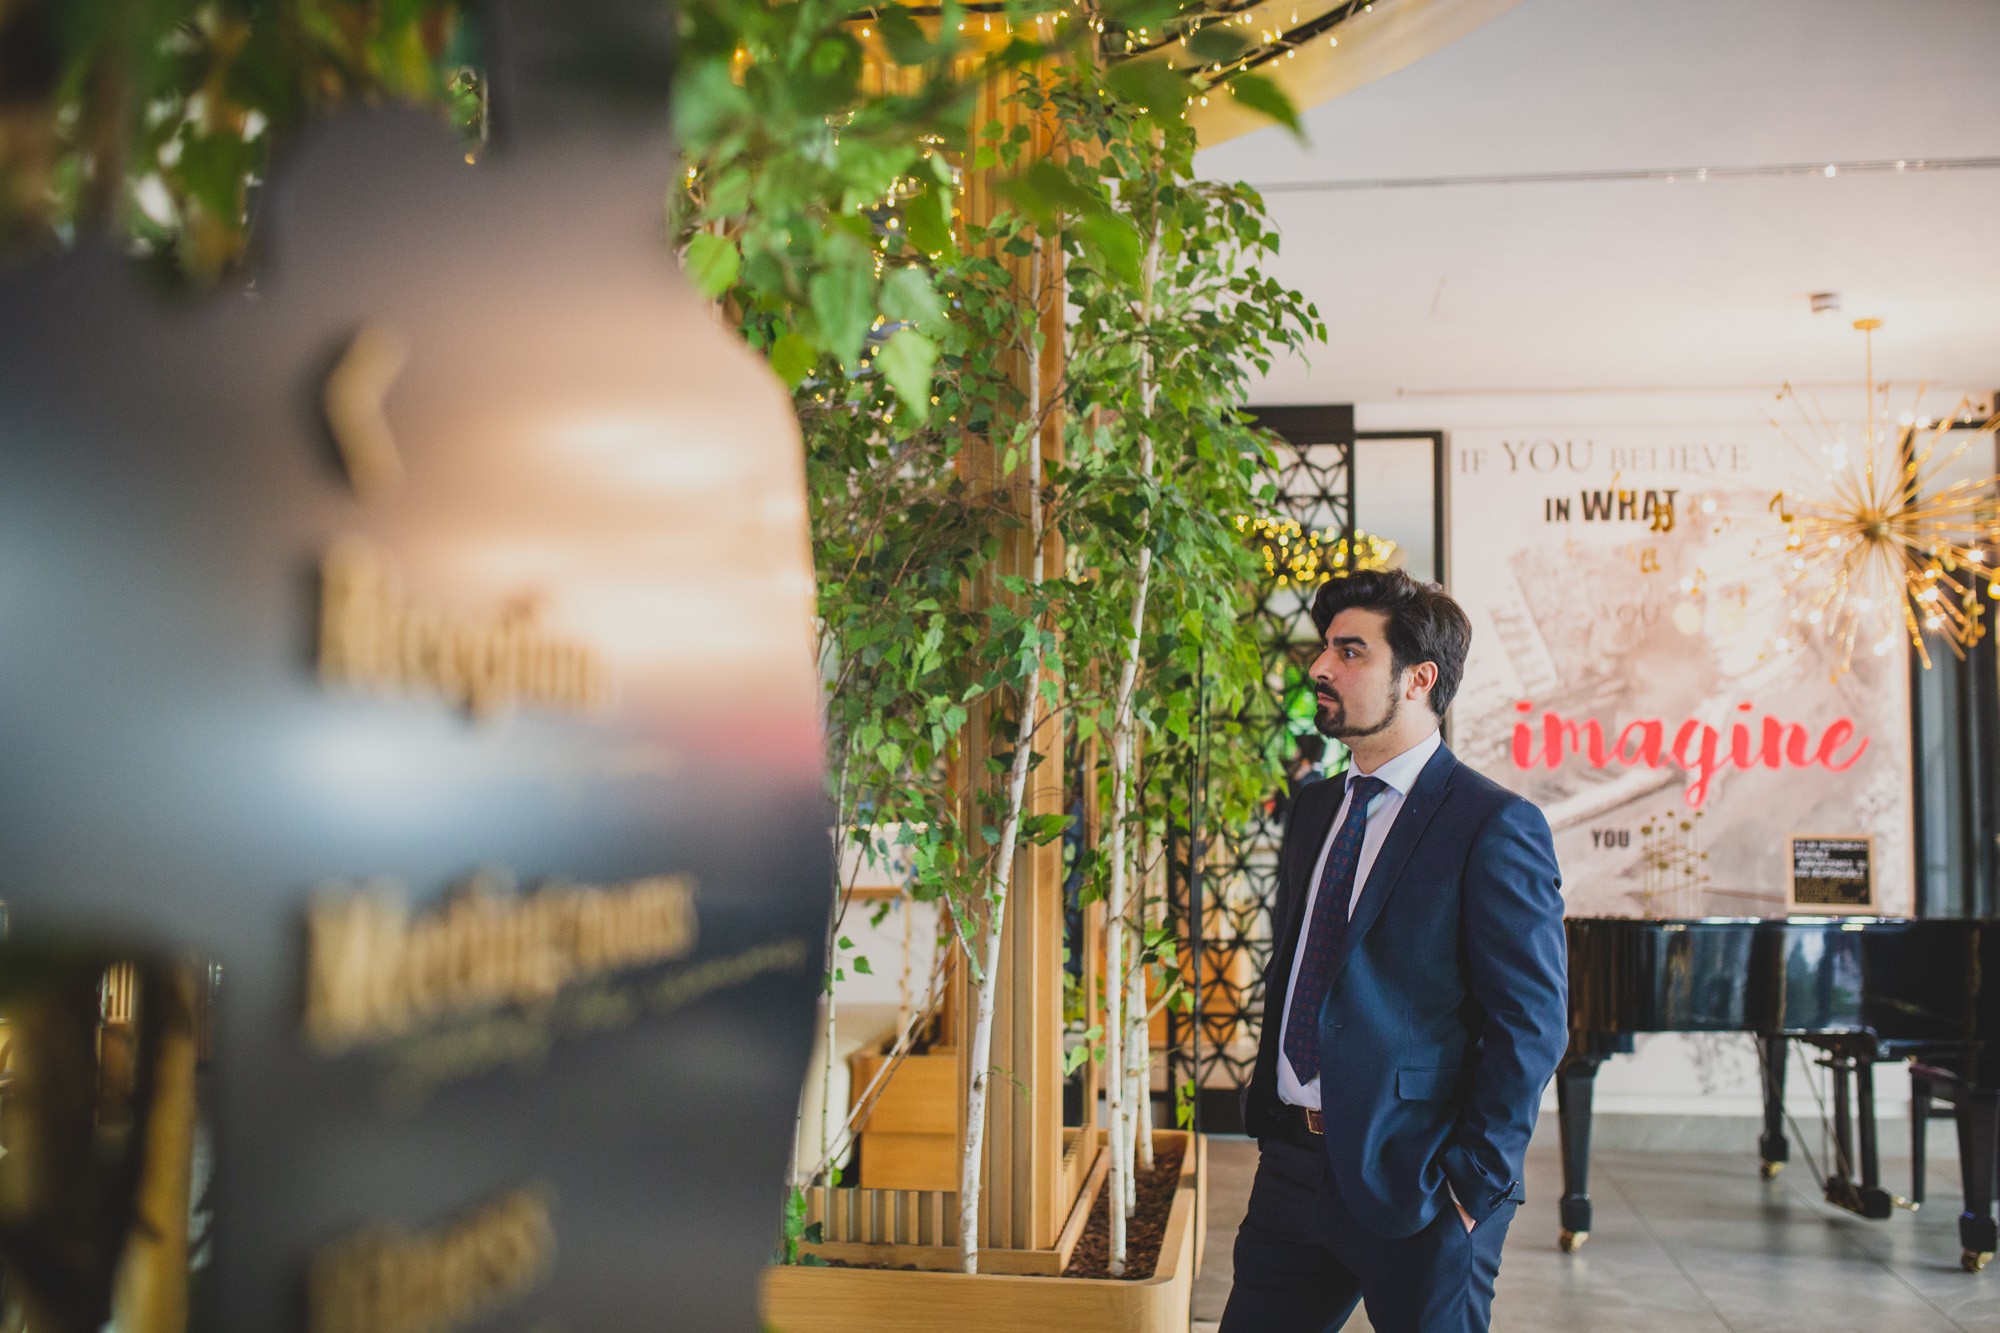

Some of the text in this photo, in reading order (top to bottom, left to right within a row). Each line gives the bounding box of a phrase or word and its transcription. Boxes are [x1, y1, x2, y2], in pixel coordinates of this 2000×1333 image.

[1460, 440, 1750, 474] IF YOU BELIEVE
[1546, 490, 1679, 522] IN WHAT
[1511, 702, 1870, 809] imagine
[1592, 829, 1630, 848] YOU
